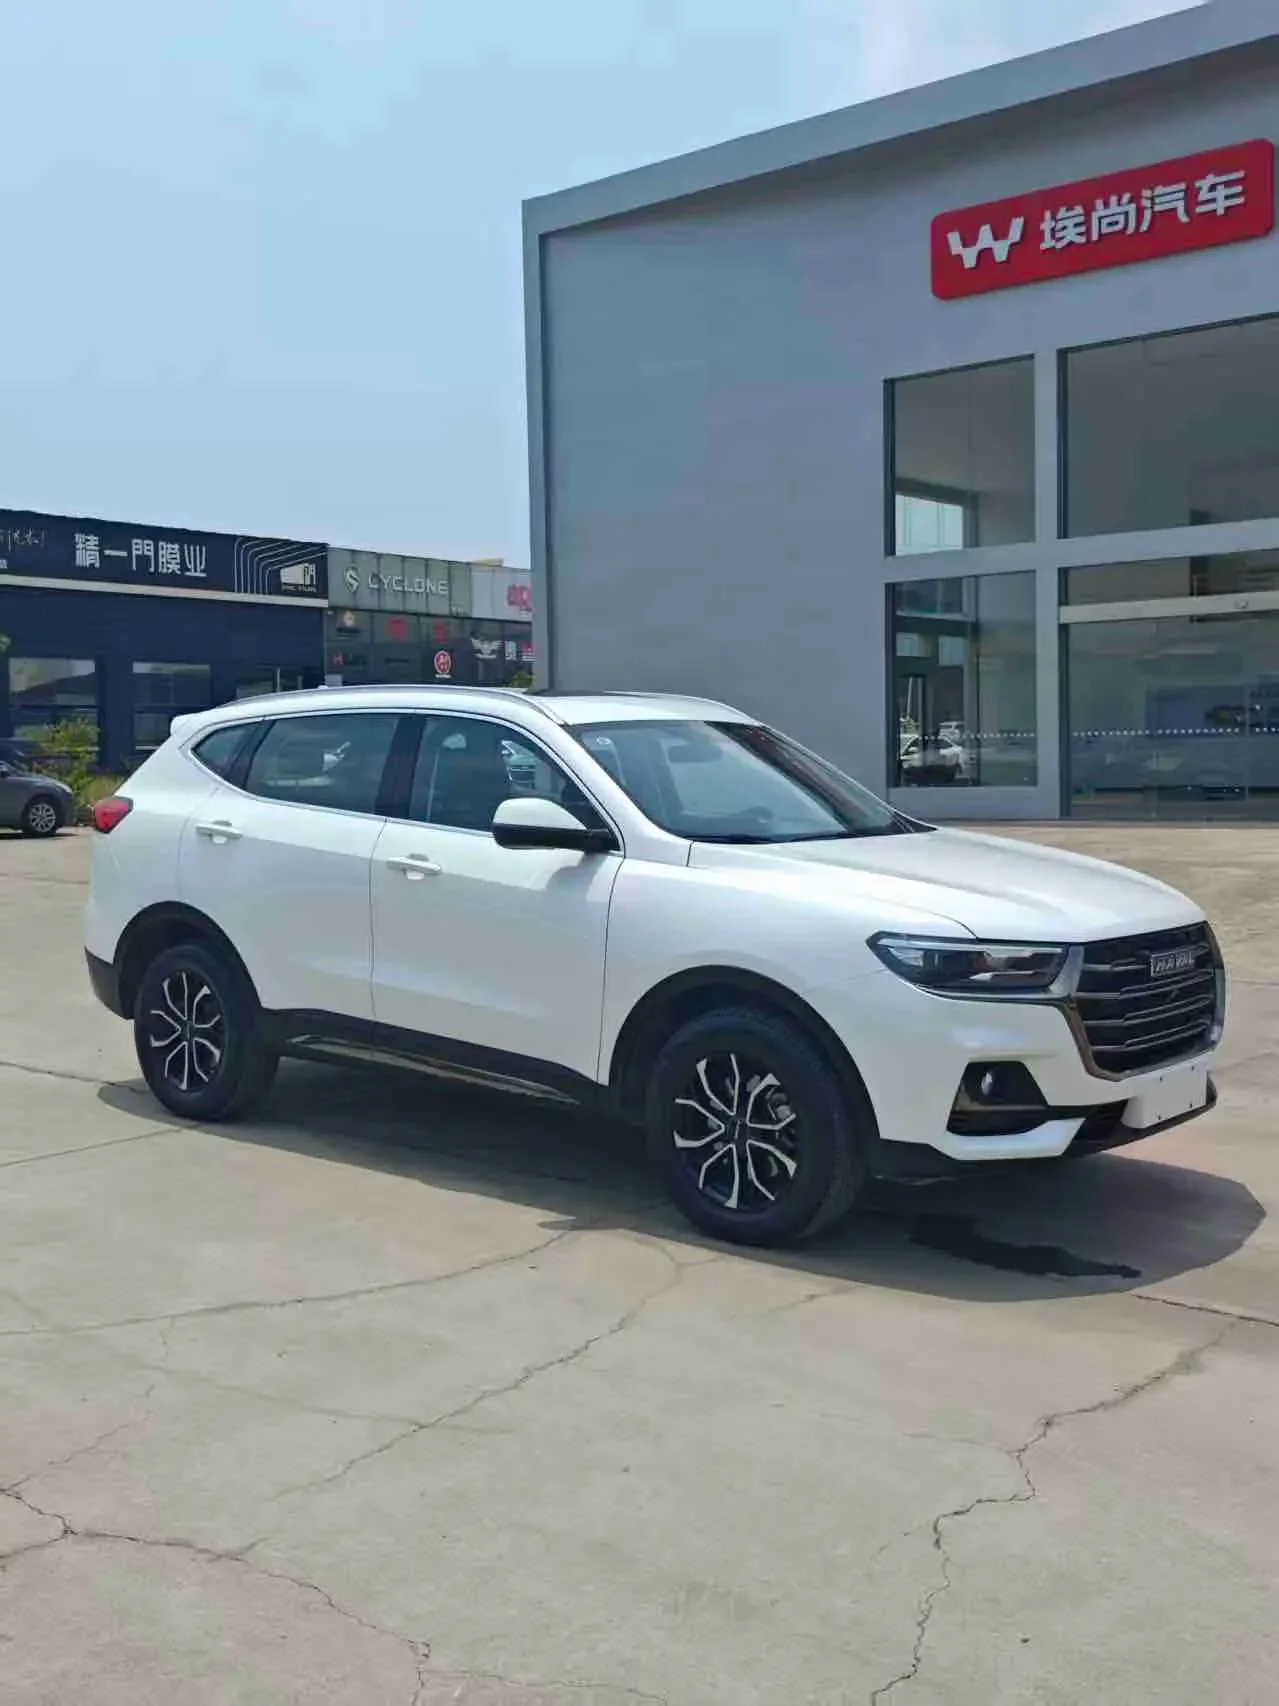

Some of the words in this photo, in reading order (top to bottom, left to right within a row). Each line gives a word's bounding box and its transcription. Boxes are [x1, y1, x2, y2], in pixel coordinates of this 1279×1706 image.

[1039, 169, 1246, 250] 埃尚汽车
[367, 572, 449, 595] CYCLONE
